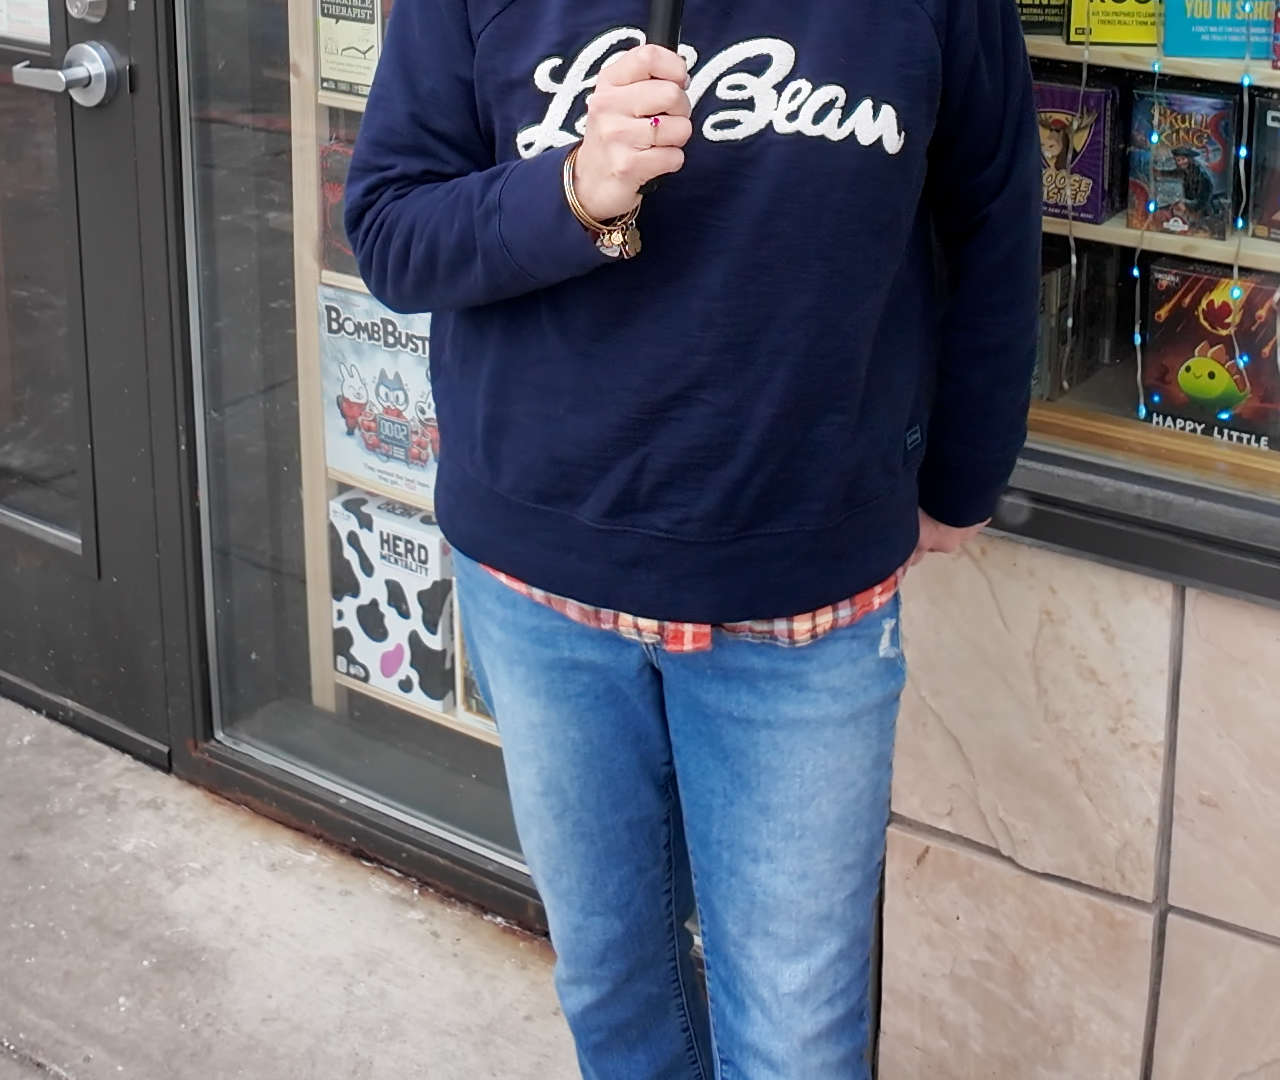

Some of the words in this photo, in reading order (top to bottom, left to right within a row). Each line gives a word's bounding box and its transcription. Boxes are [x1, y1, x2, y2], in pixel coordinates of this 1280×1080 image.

[322, 3, 373, 20] THERAPIST
[1185, 0, 1216, 19] YOU
[1221, 0, 1232, 20] IN
[1151, 104, 1211, 131] SKULL
[379, 419, 408, 441] 00:02
[1152, 412, 1206, 436] HAPPY
[1213, 426, 1270, 451] LITTLE
[379, 530, 430, 565] HERD
[379, 551, 430, 578] MENTALITY
